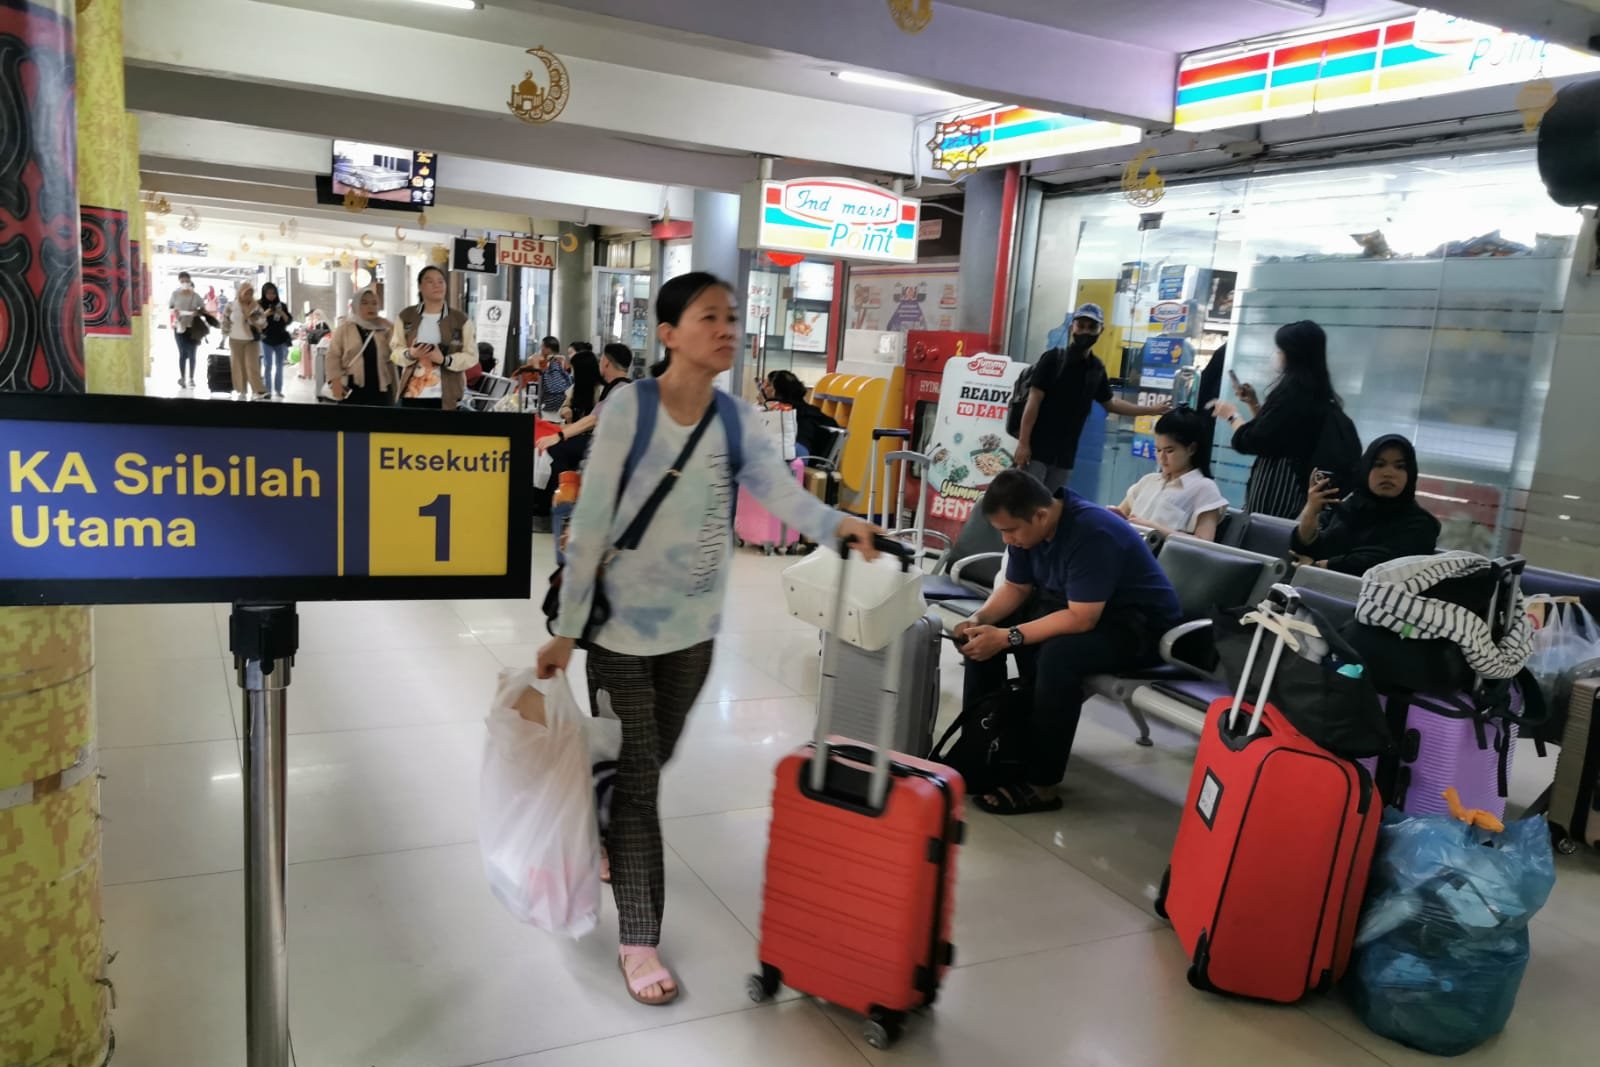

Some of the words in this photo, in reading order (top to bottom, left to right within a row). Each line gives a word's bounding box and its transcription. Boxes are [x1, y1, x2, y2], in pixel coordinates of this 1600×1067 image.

[513, 239, 544, 254] ISI
[830, 223, 894, 253] Point
[501, 250, 554, 267] PULSA
[919, 380, 941, 394] HYDR
[960, 386, 1011, 404] READY
[959, 403, 974, 415] TO
[976, 404, 1009, 419] EAT
[379, 447, 511, 473] Eksekutif
[9, 450, 97, 494] KA
[114, 452, 321, 498] Sribilah
[11, 505, 196, 548] Utama
[418, 494, 451, 562] 1
